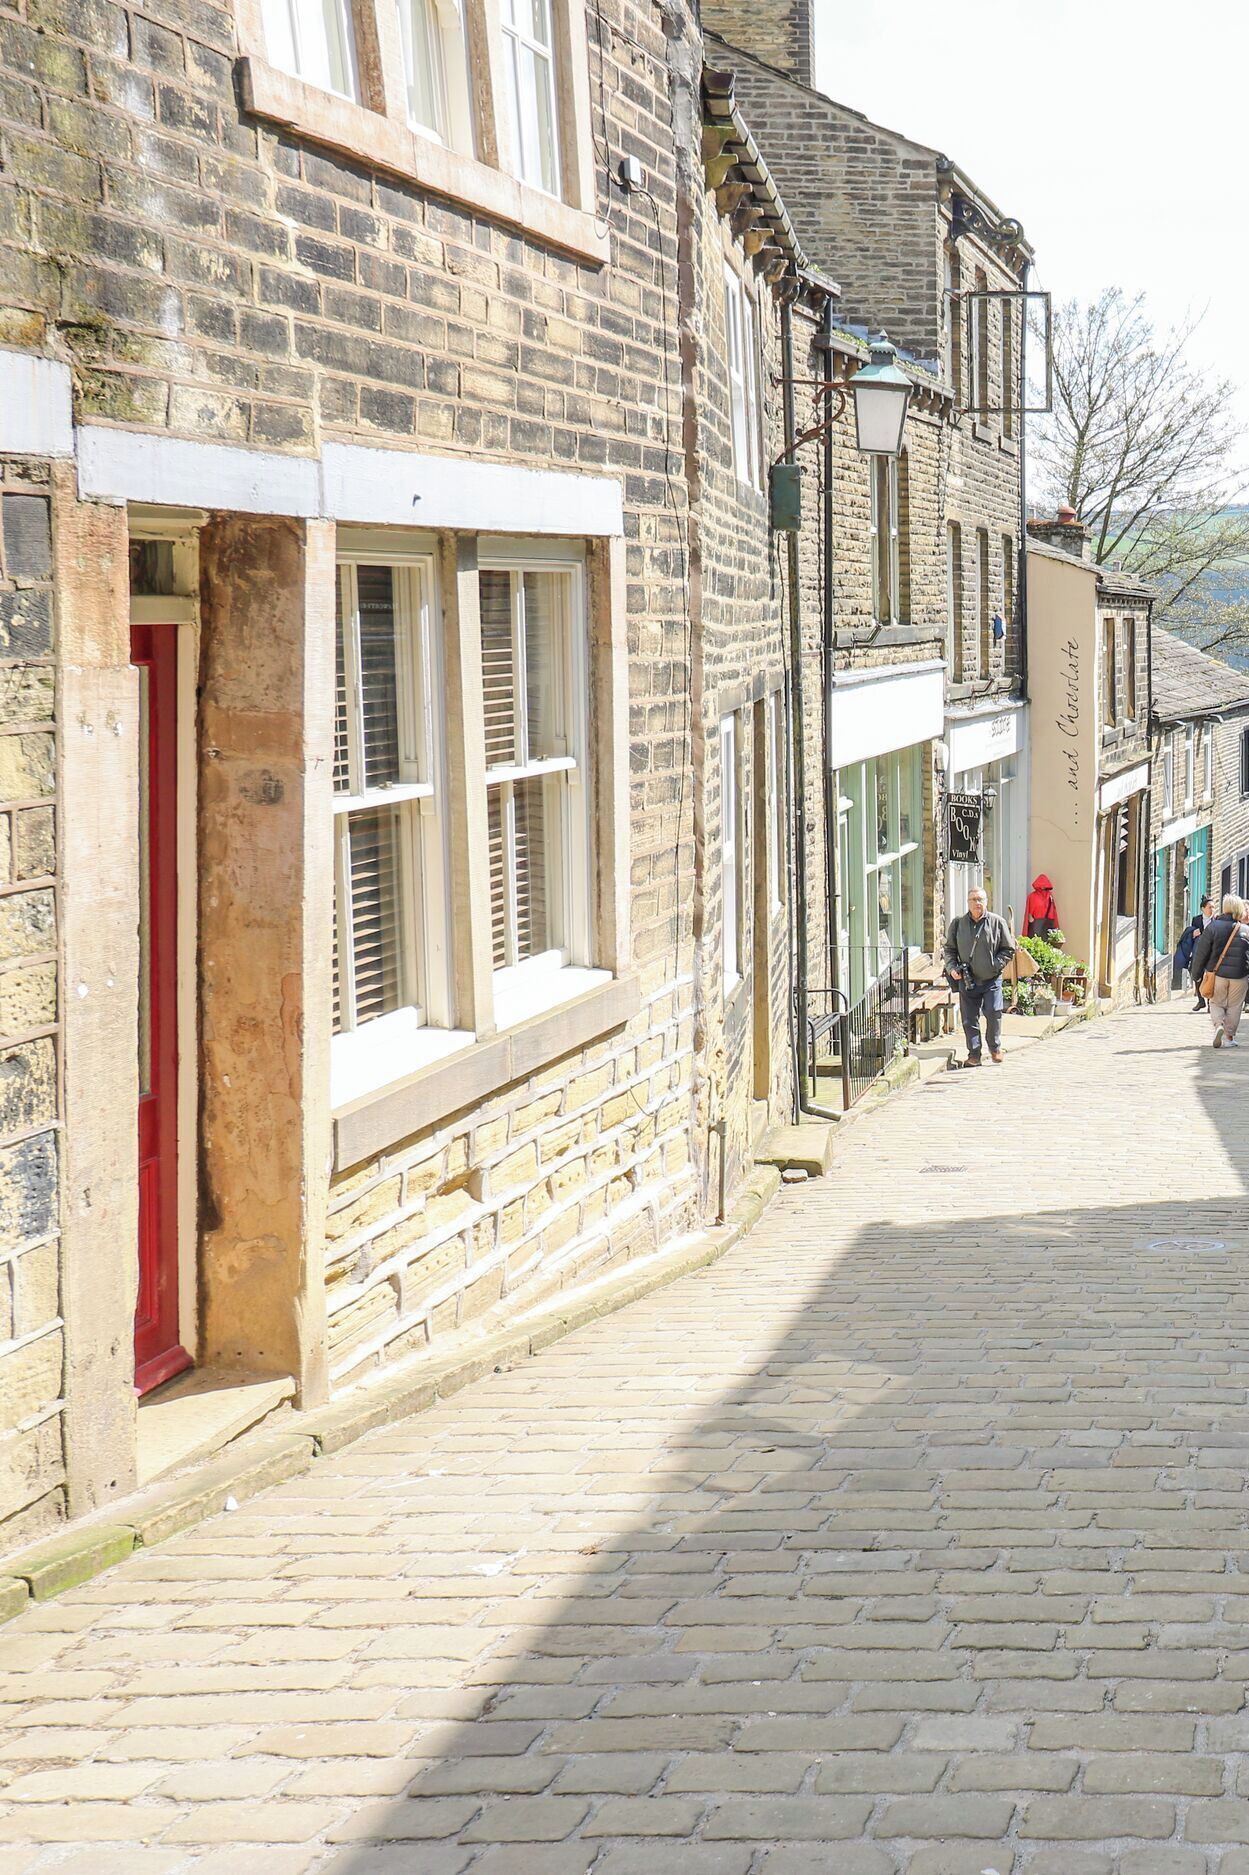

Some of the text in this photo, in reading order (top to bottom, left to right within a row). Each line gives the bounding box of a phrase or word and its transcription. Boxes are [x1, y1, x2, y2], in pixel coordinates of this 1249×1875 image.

[1055, 636, 1080, 737] Chocolate
[1062, 748, 1080, 791] and
[951, 794, 978, 804] BOOKS
[952, 849, 969, 860] Vinyl
